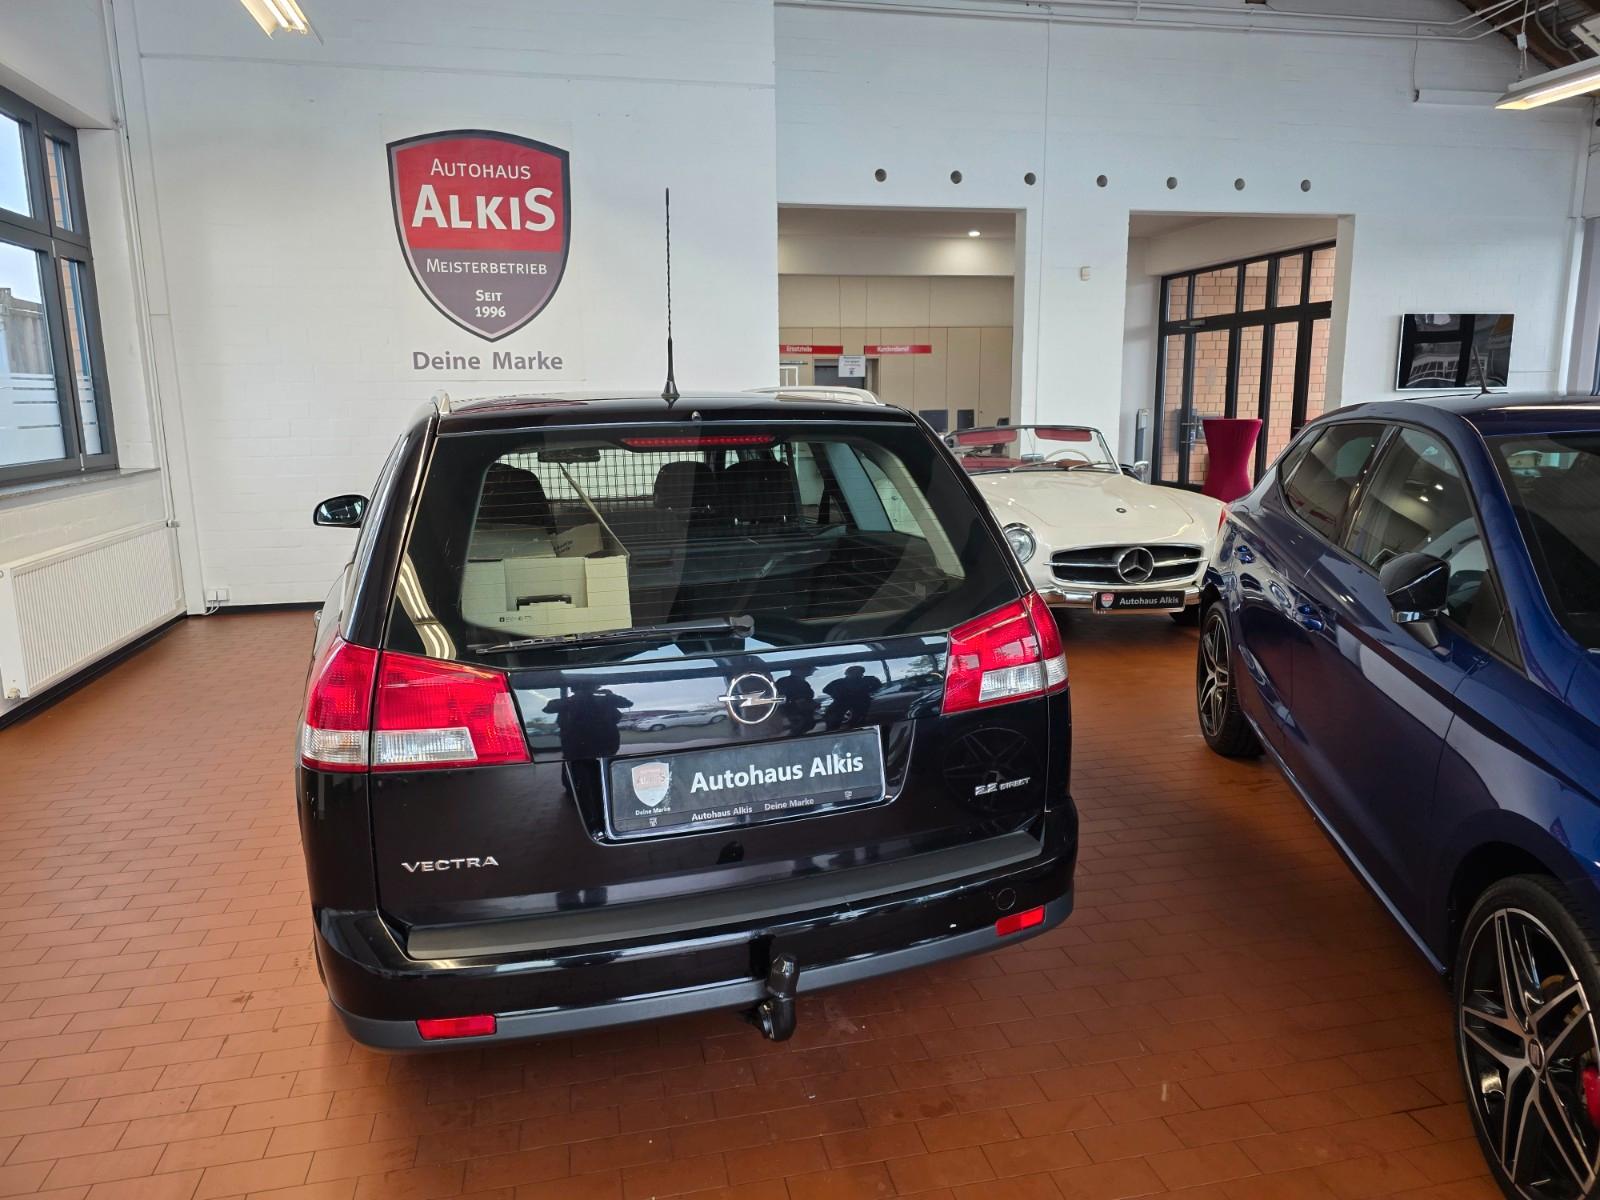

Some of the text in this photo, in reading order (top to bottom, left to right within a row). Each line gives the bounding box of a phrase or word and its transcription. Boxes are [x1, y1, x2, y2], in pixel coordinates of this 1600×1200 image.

[430, 158, 532, 180] AUTOHAUS
[411, 184, 556, 232] ALKIS
[426, 258, 548, 275] MEISTERBETRIEB
[475, 289, 503, 302] SEIT
[475, 305, 506, 318] 1996
[412, 351, 563, 370] Deine Marke
[1119, 596, 1179, 606] Autohaus Alkis
[690, 752, 864, 794] Autohaus Alkis
[652, 806, 671, 814] Marke
[691, 797, 815, 822] Autohaus Alkis Deine Marke
[401, 856, 499, 873] VECTRA
